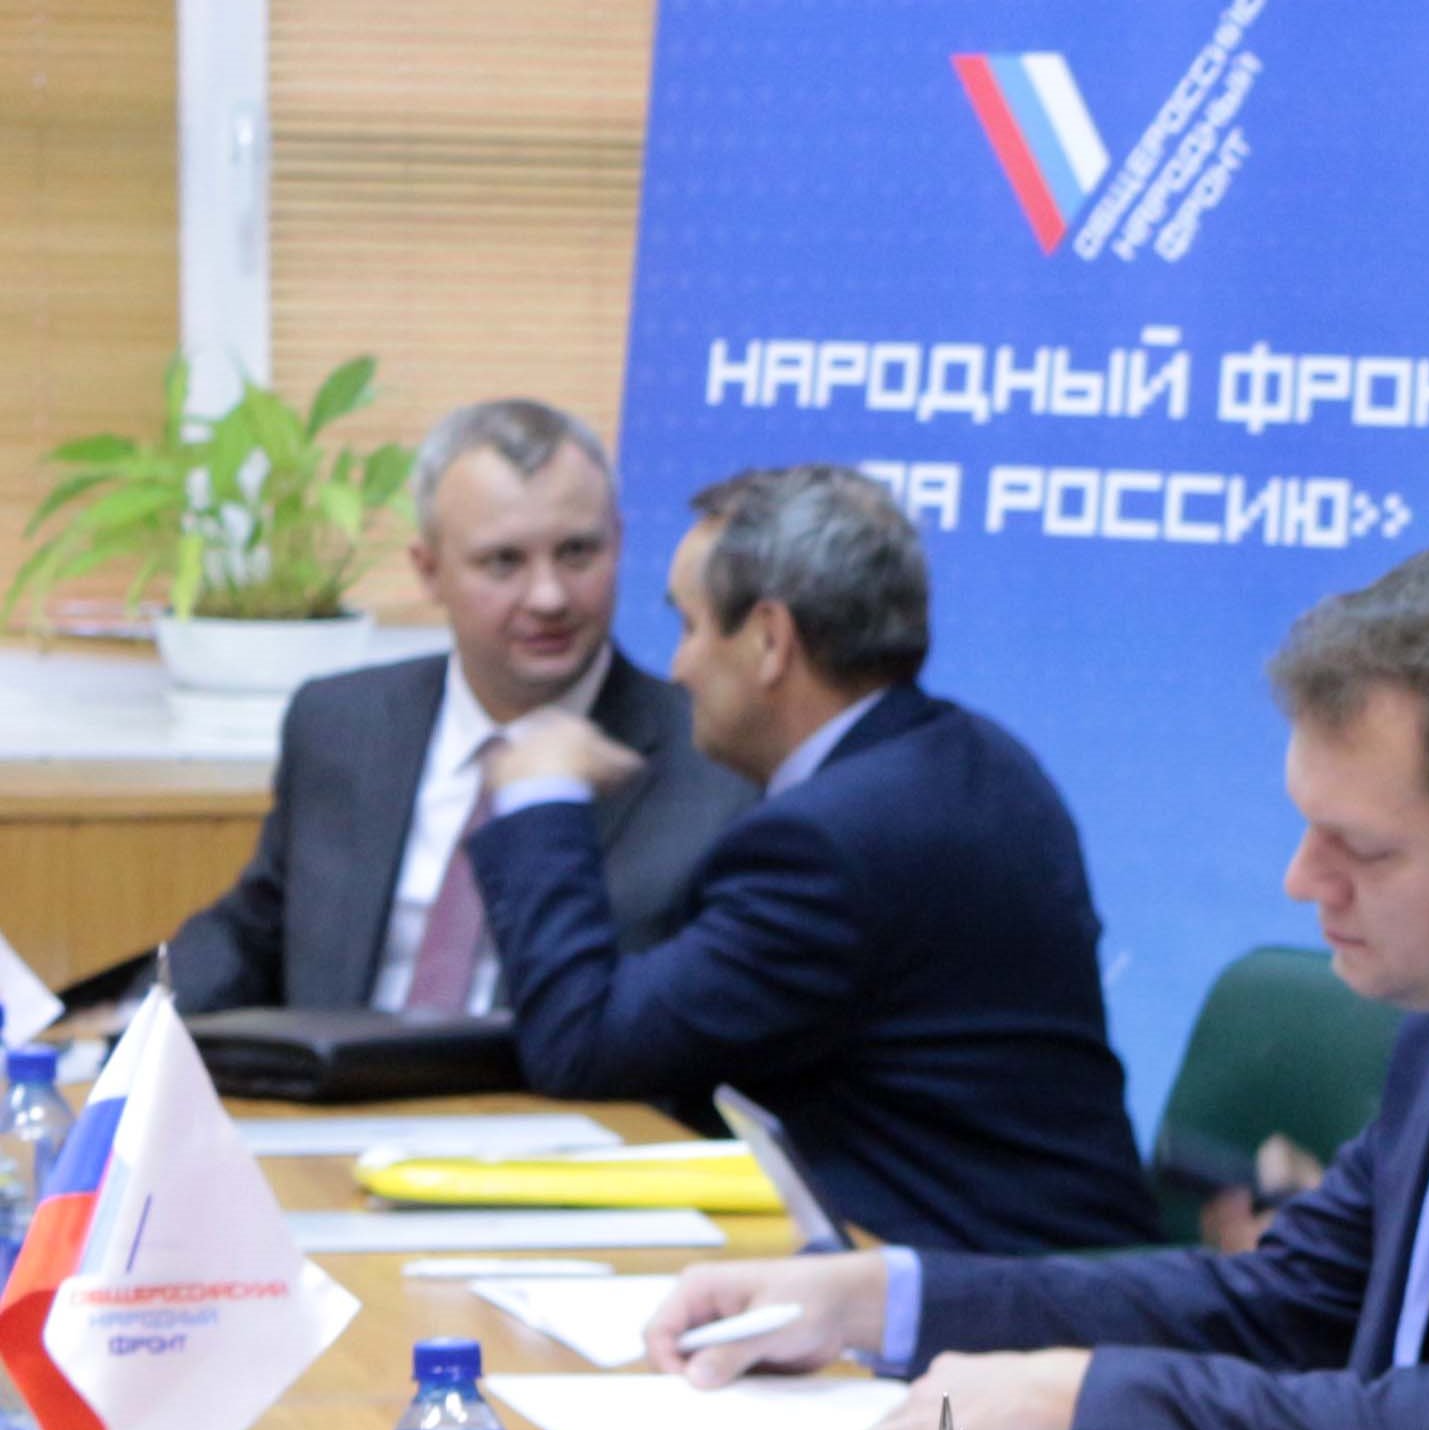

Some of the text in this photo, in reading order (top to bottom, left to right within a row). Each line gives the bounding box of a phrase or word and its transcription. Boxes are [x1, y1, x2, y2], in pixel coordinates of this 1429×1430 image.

[1153, 125, 1251, 262] ФРОНТ
[705, 324, 1190, 425] НАРОДНЫЙ
[984, 463, 1413, 549] РОССИЮ»
[107, 1332, 188, 1356] ФРОНТ
